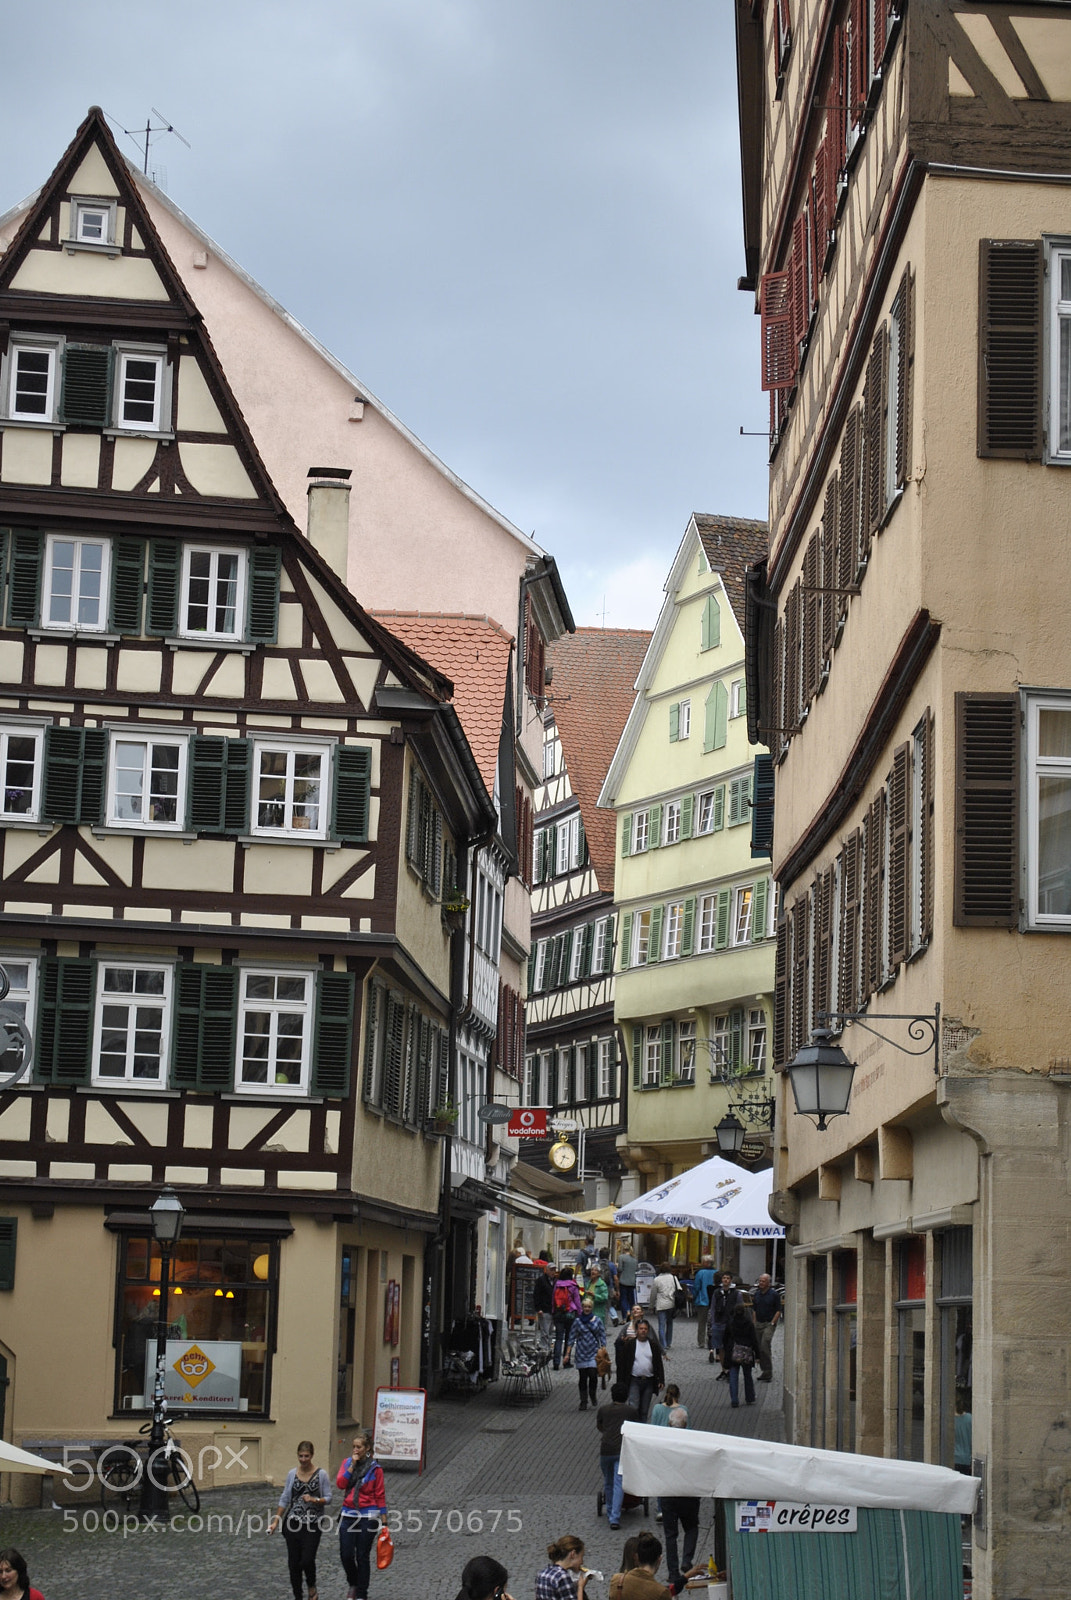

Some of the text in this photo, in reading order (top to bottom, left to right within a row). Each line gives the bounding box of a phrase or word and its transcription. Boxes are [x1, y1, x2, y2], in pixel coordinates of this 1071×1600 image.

[509, 1127, 545, 1135] vodafone
[192, 1394, 234, 1402] Konditorei
[777, 1503, 851, 1529] crêpes
